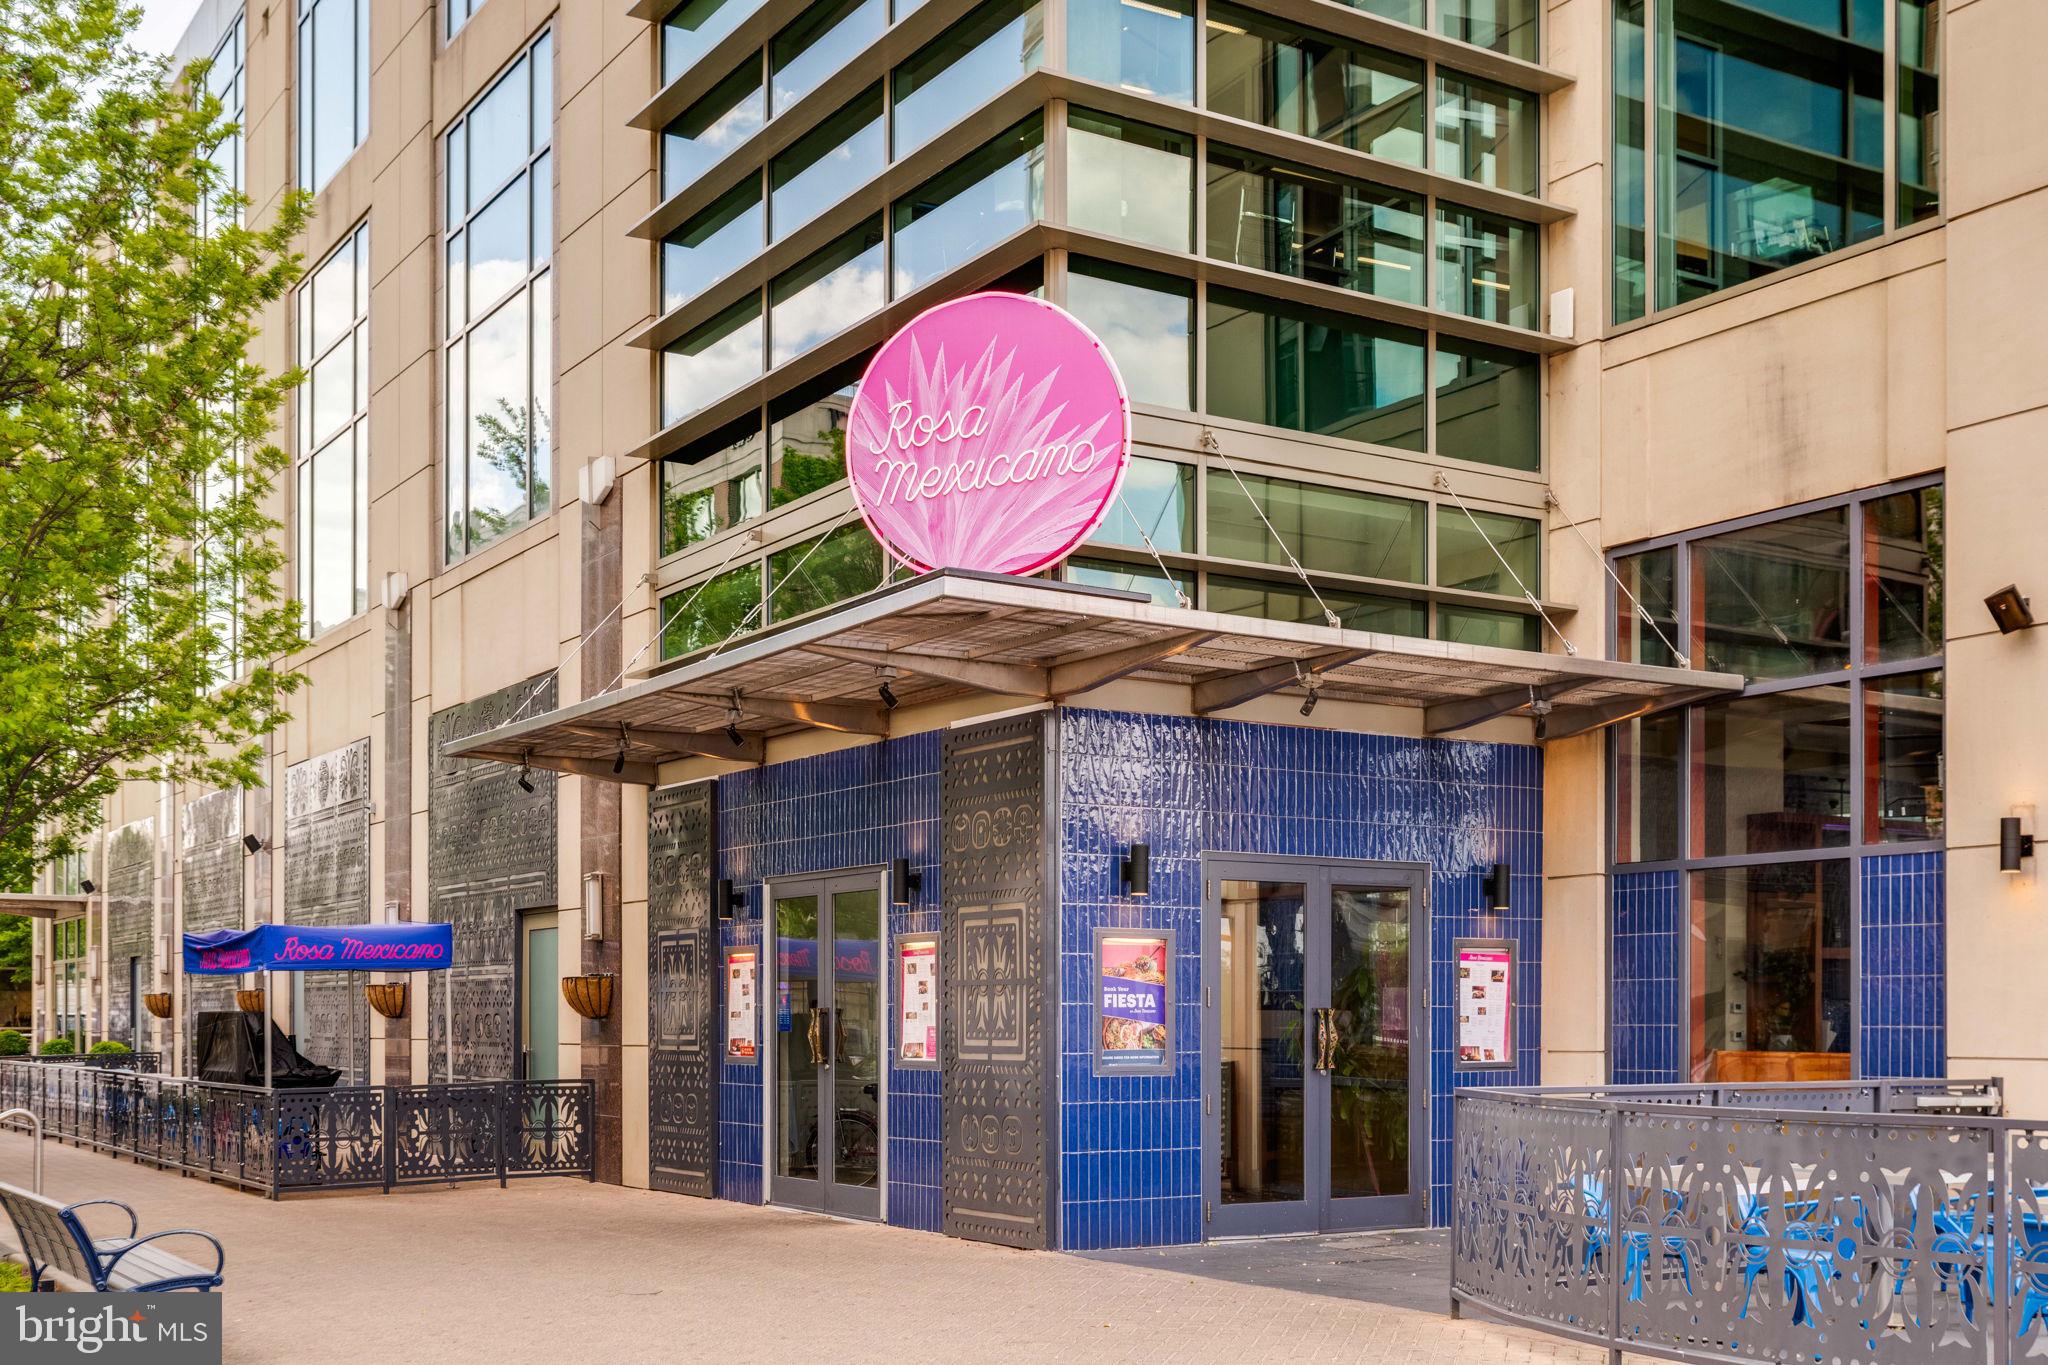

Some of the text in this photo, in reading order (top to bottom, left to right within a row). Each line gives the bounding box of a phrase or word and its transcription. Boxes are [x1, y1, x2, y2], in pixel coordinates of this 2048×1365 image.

[870, 400, 989, 455] Rosa
[274, 936, 334, 961] Rosa
[340, 937, 444, 960] Mexicano
[1103, 993, 1156, 1008] FIESTA
